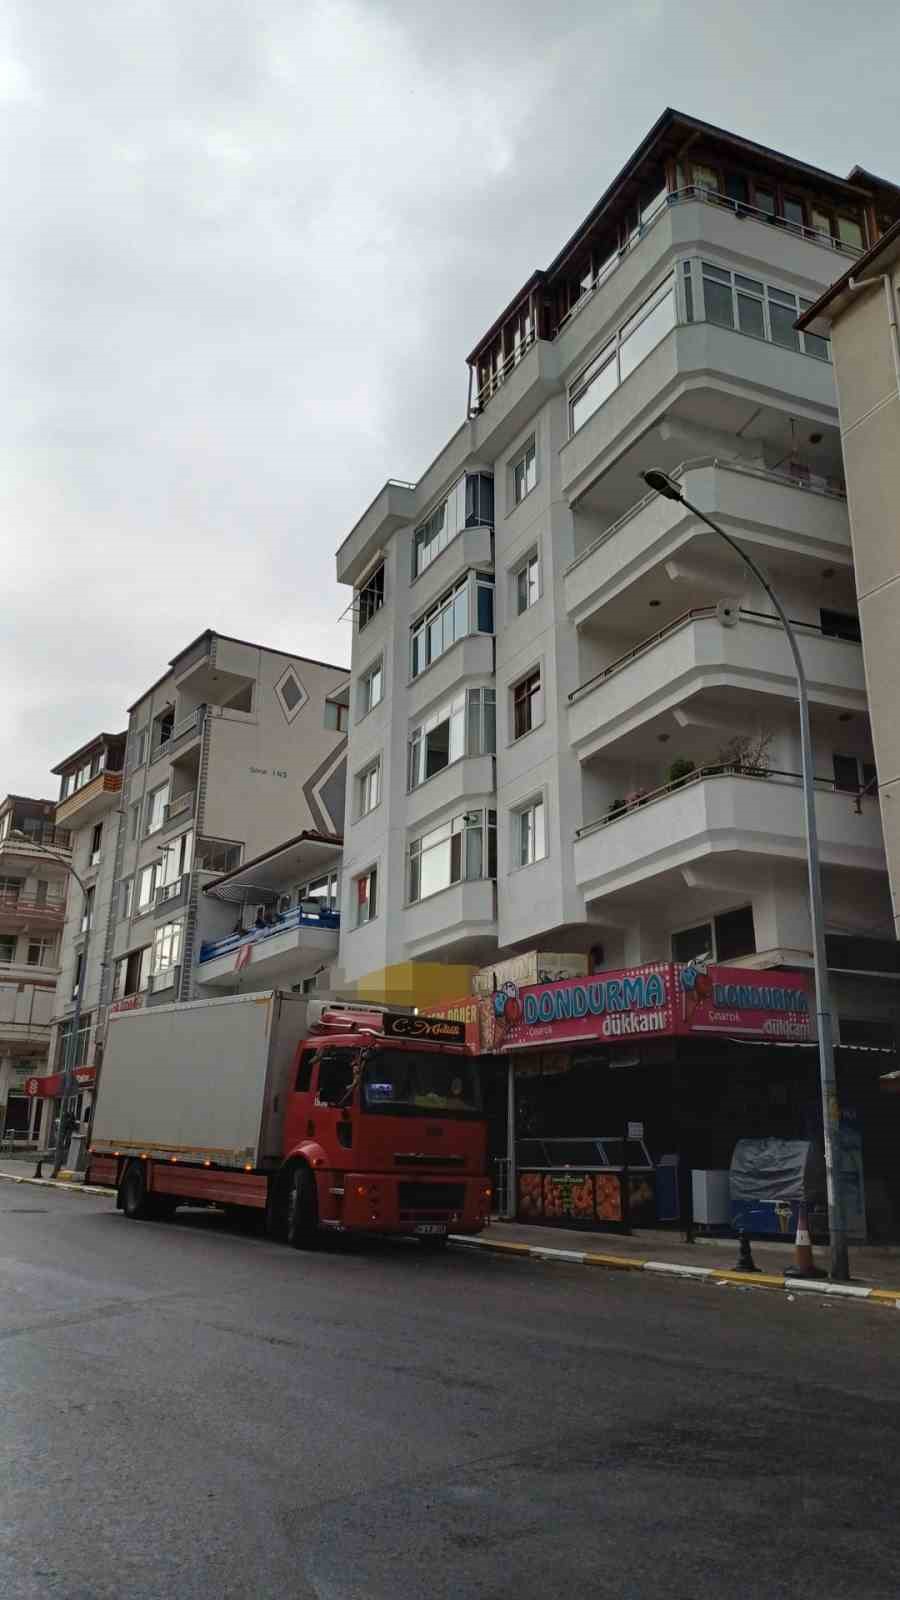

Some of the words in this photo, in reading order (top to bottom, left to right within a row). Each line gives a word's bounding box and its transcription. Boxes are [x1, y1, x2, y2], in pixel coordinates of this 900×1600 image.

[523, 974, 665, 1024] DONDURMA
[714, 984, 808, 1011] DONDURMA
[602, 1013, 664, 1036] dükkanı
